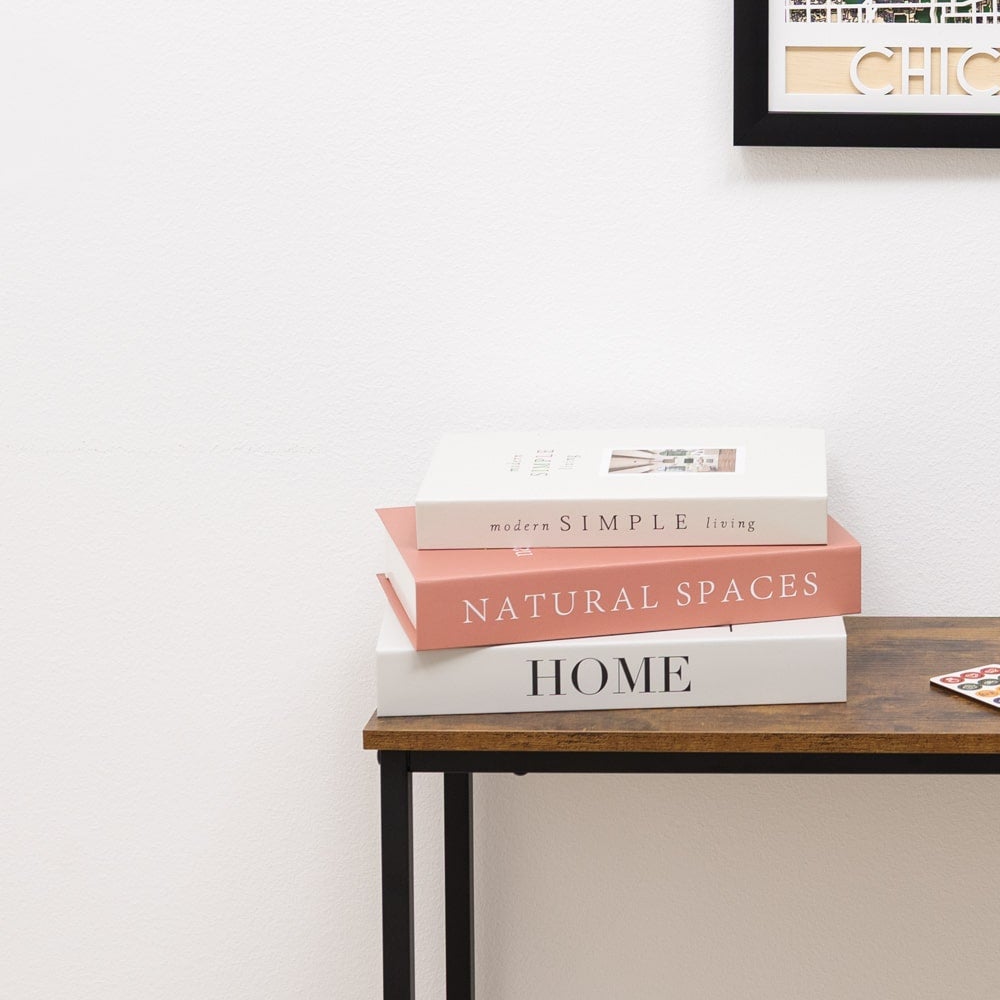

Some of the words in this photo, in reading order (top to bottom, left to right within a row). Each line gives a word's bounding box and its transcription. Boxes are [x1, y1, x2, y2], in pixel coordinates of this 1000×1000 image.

[489, 519, 550, 532] modern
[560, 513, 688, 532] SIMPLE
[706, 516, 756, 532] living
[462, 584, 659, 625] NATURAL
[675, 571, 819, 608] SPACES
[526, 655, 692, 697] HOME
